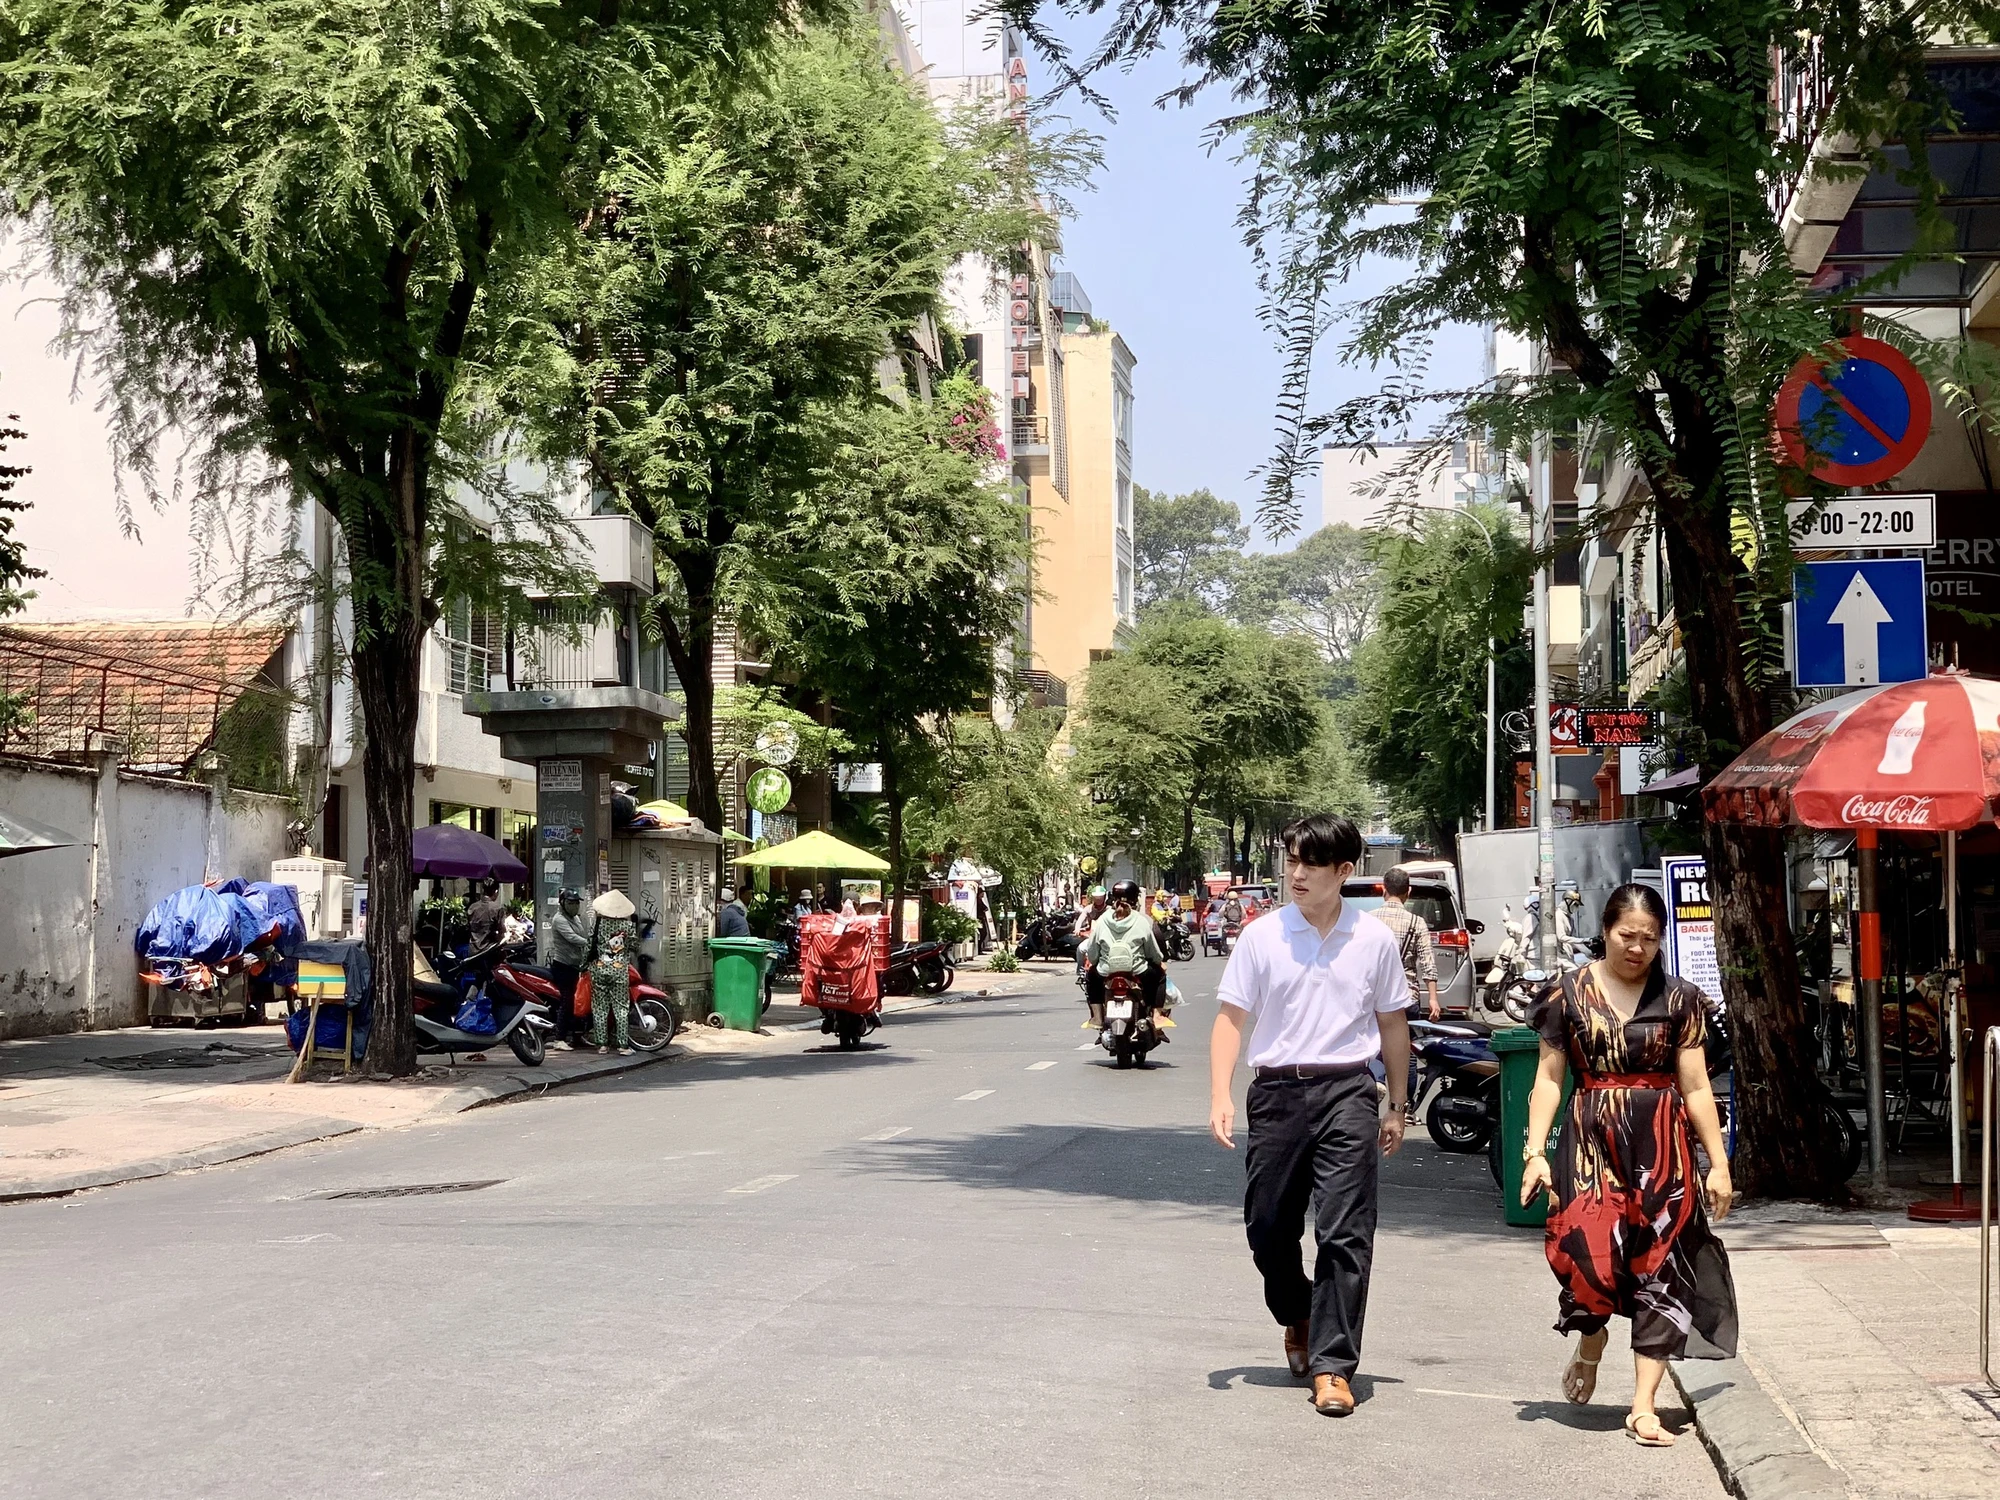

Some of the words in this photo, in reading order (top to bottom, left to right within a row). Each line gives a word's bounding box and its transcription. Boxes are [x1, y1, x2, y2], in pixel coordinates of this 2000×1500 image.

[1011, 274, 1029, 398] HOTEL
[1925, 580, 1981, 596] OTEL
[1639, 746, 1651, 789] AIGON
[1841, 794, 1936, 824] Coca-Cola
[1675, 905, 1711, 919] TAIWAN
